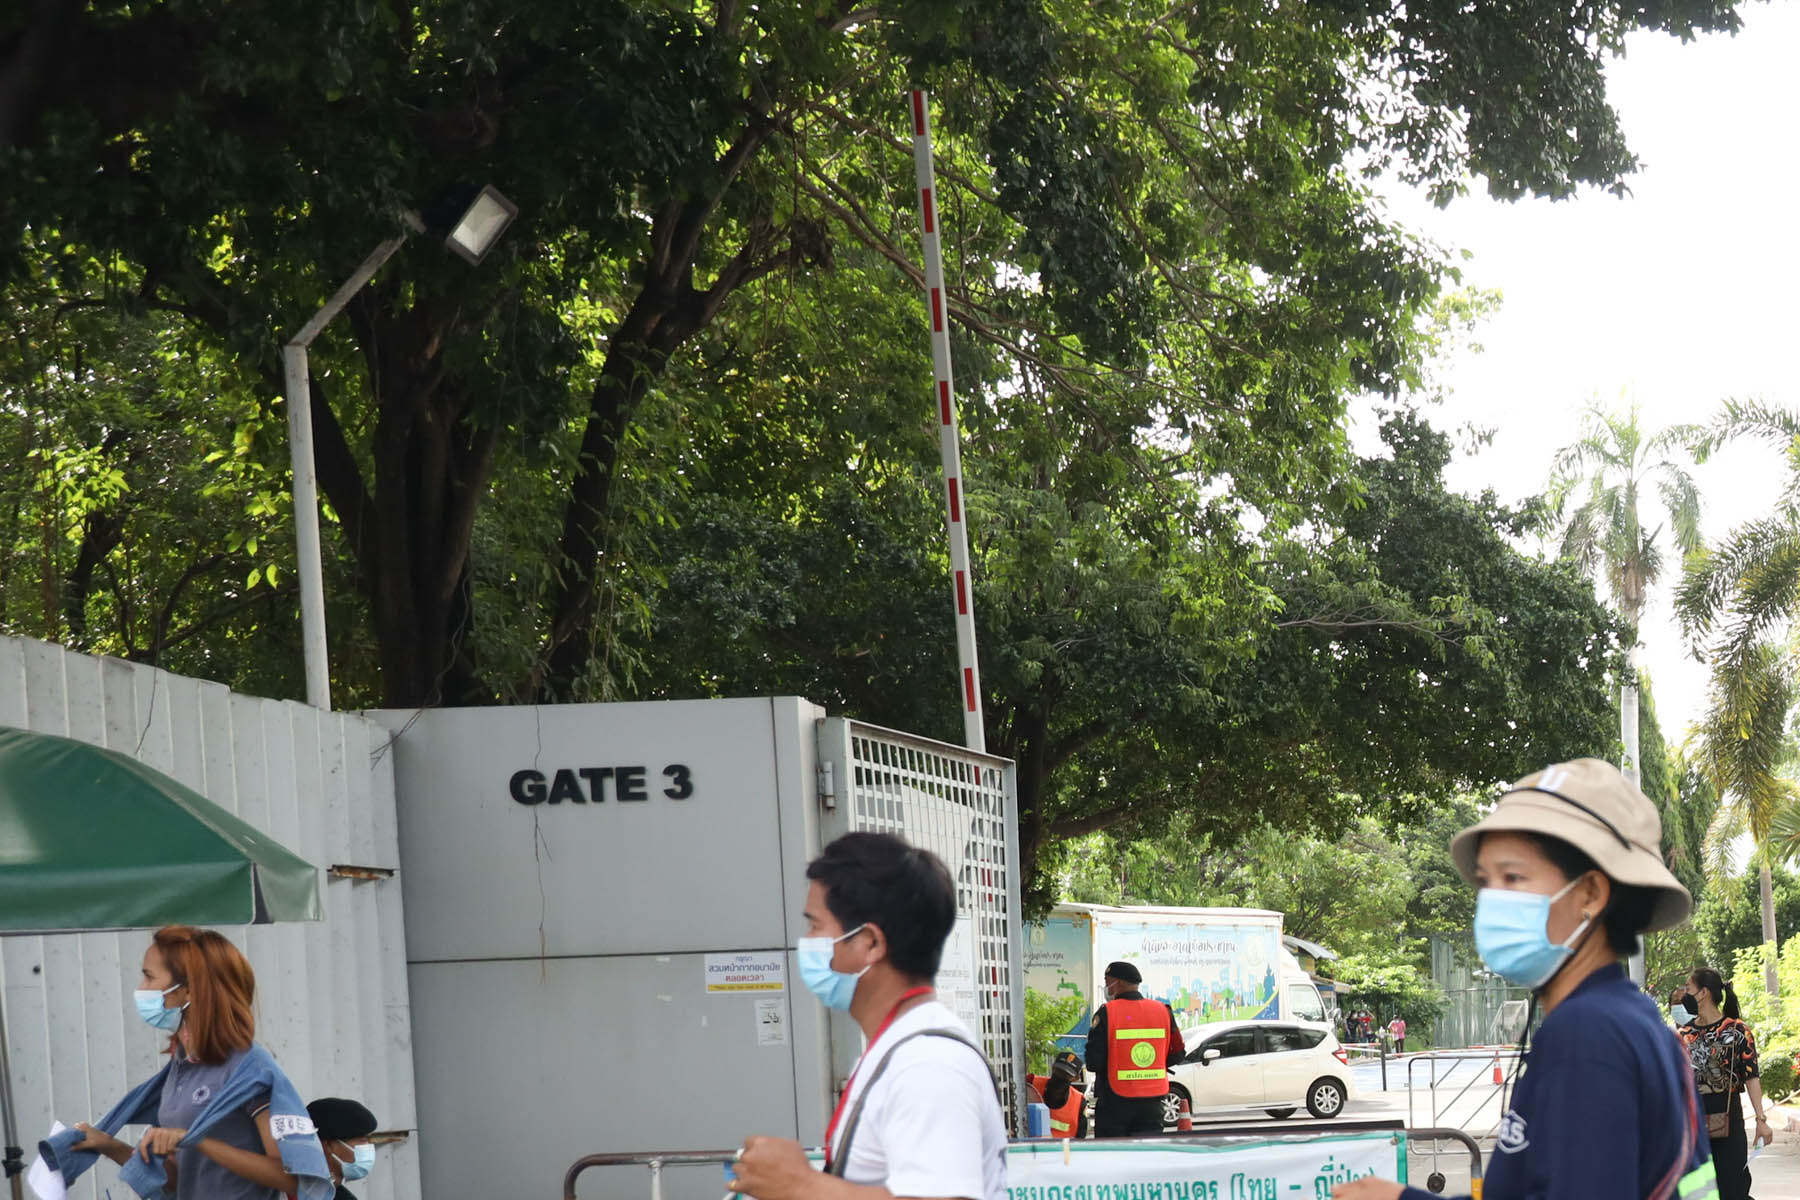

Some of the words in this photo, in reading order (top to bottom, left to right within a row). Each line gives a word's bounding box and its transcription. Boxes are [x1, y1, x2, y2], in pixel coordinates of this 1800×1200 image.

[509, 766, 648, 806] GATE
[662, 764, 694, 801] 3
[708, 962, 781, 973] สวมหน้ากากอนามัย
